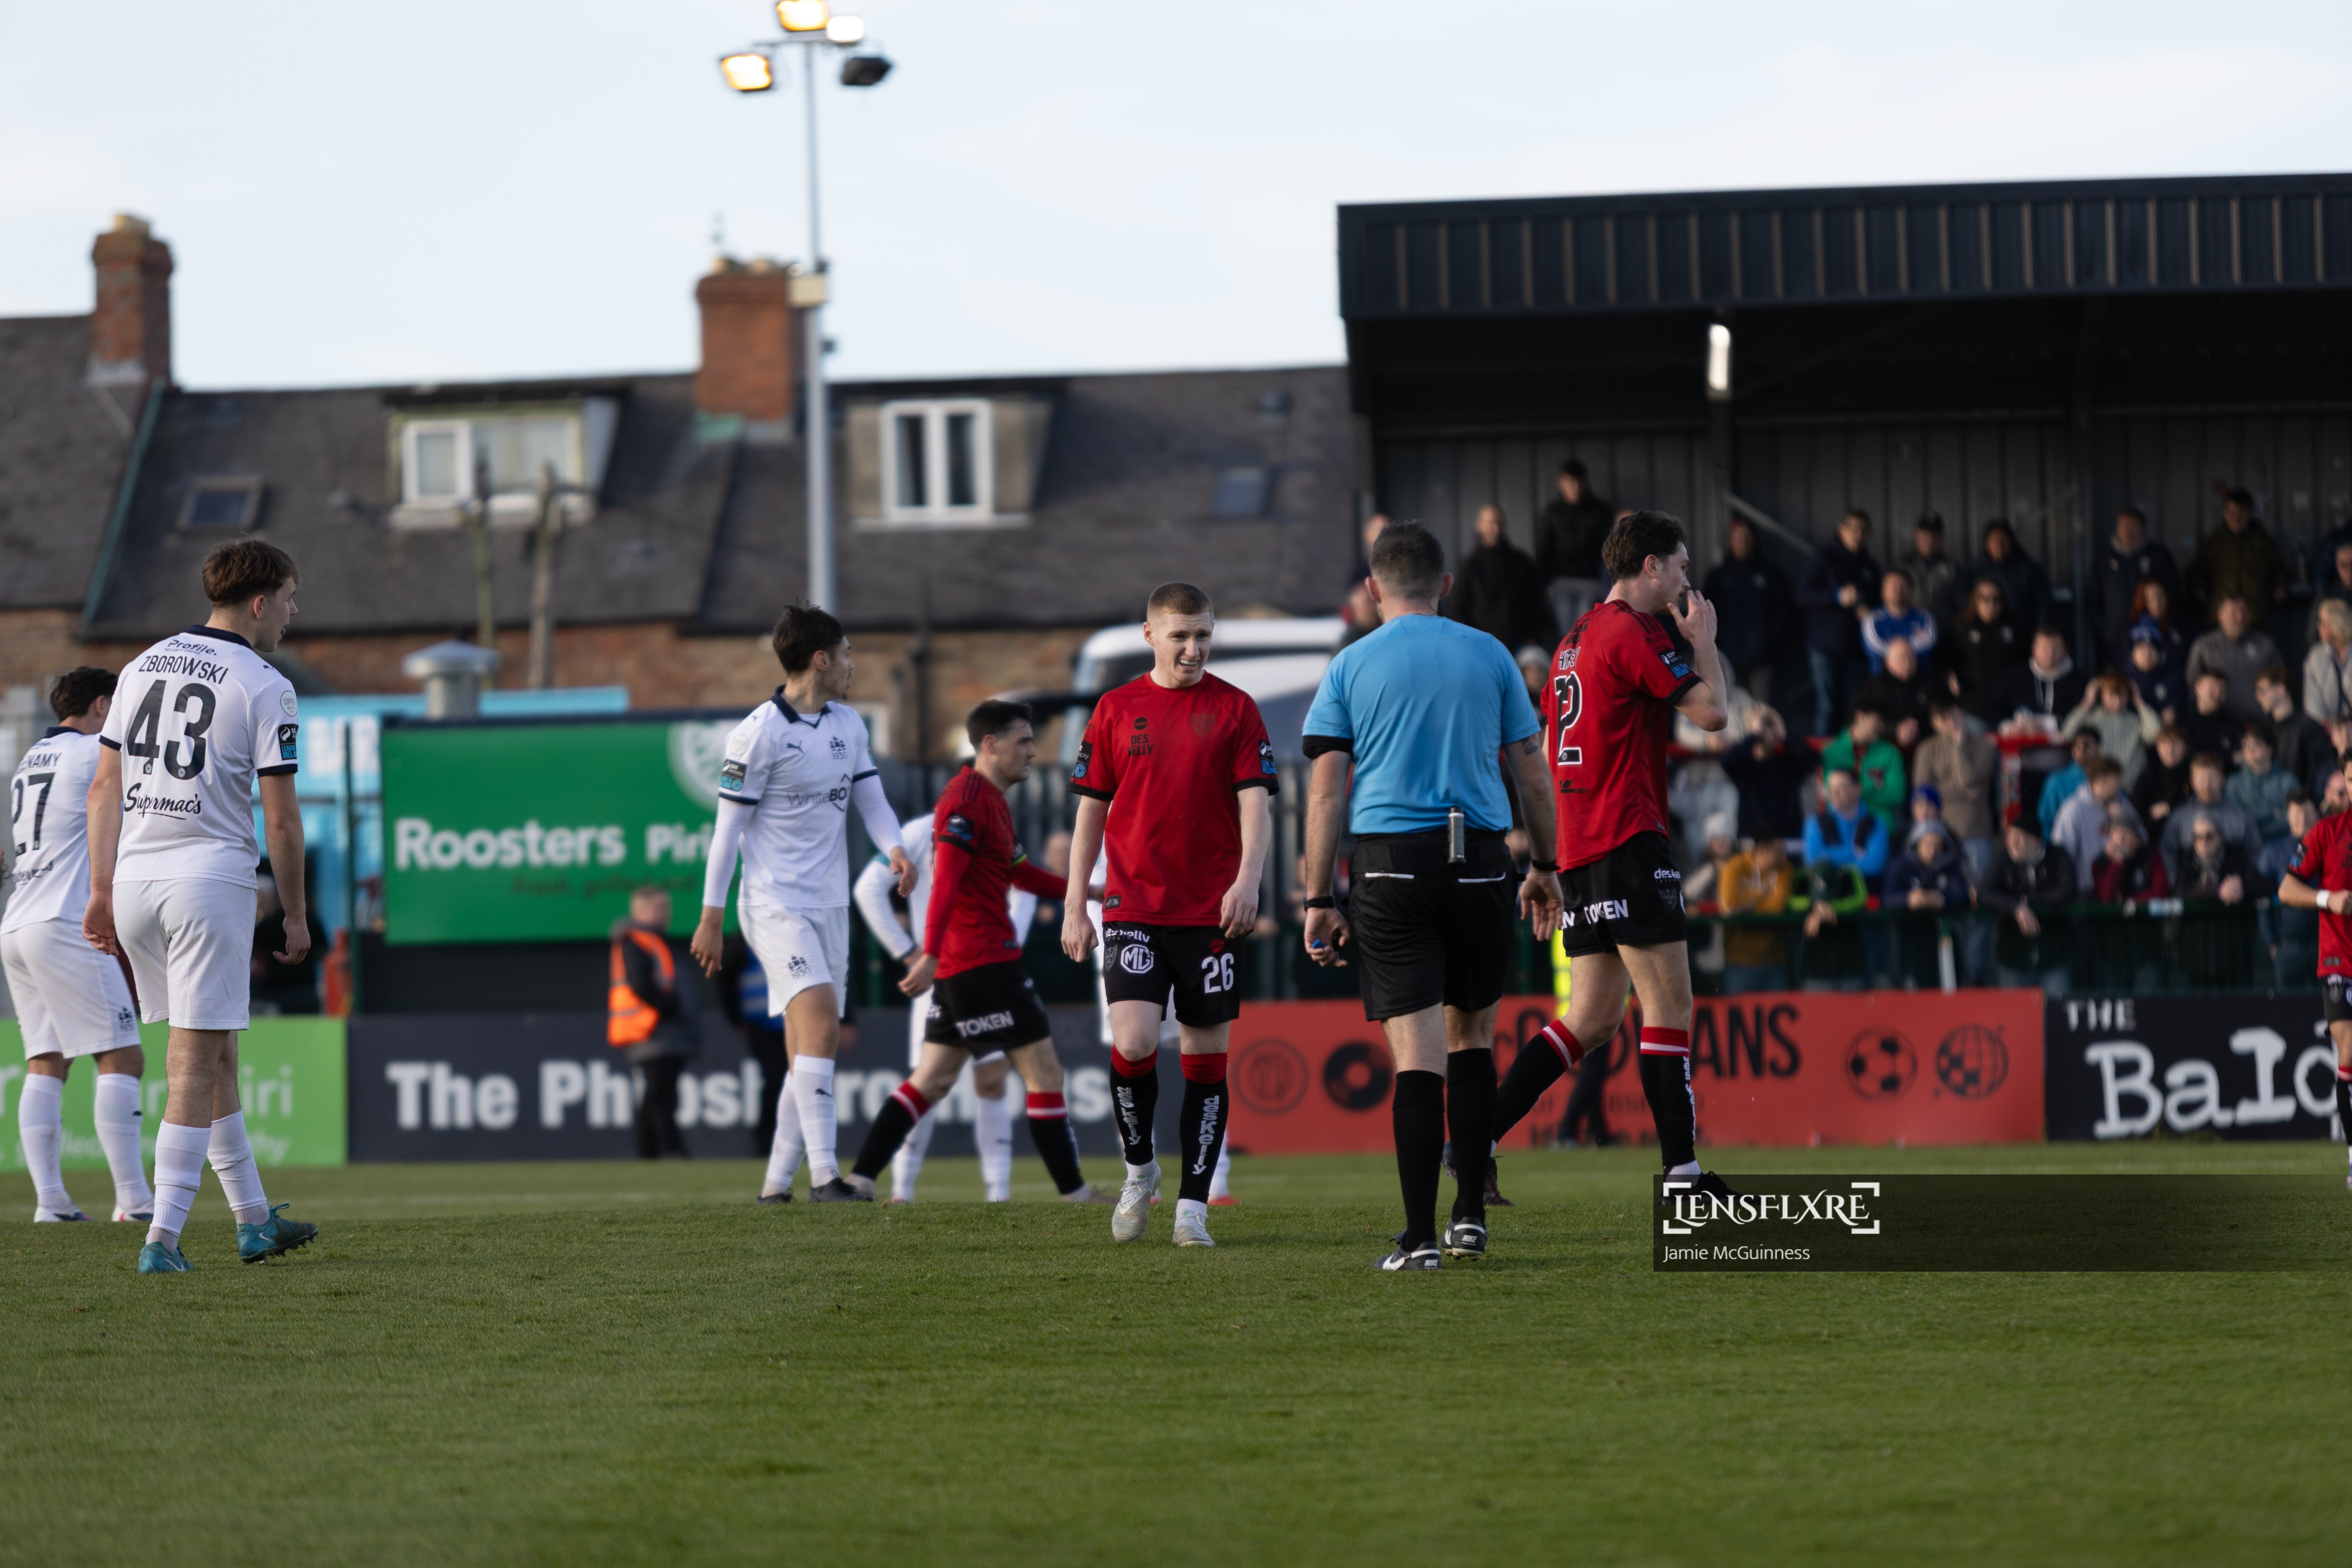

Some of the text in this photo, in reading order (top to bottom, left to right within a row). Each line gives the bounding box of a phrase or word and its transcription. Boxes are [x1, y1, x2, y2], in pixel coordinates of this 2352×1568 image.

[138, 655, 229, 684] ZBOROWSKI
[127, 679, 216, 780] 43
[1131, 733, 1149, 745] DES
[833, 751, 848, 760] 1930
[787, 786, 850, 806] WhiteBO
[394, 817, 626, 871] Roosters
[1584, 899, 1629, 924] TOKEN
[1125, 947, 1151, 970] MG
[792, 967, 811, 980] 1930
[1201, 953, 1234, 993] 26
[955, 1011, 1014, 1037] TOKEN
[2064, 998, 2136, 1032] THE
[385, 1060, 520, 1131] The
